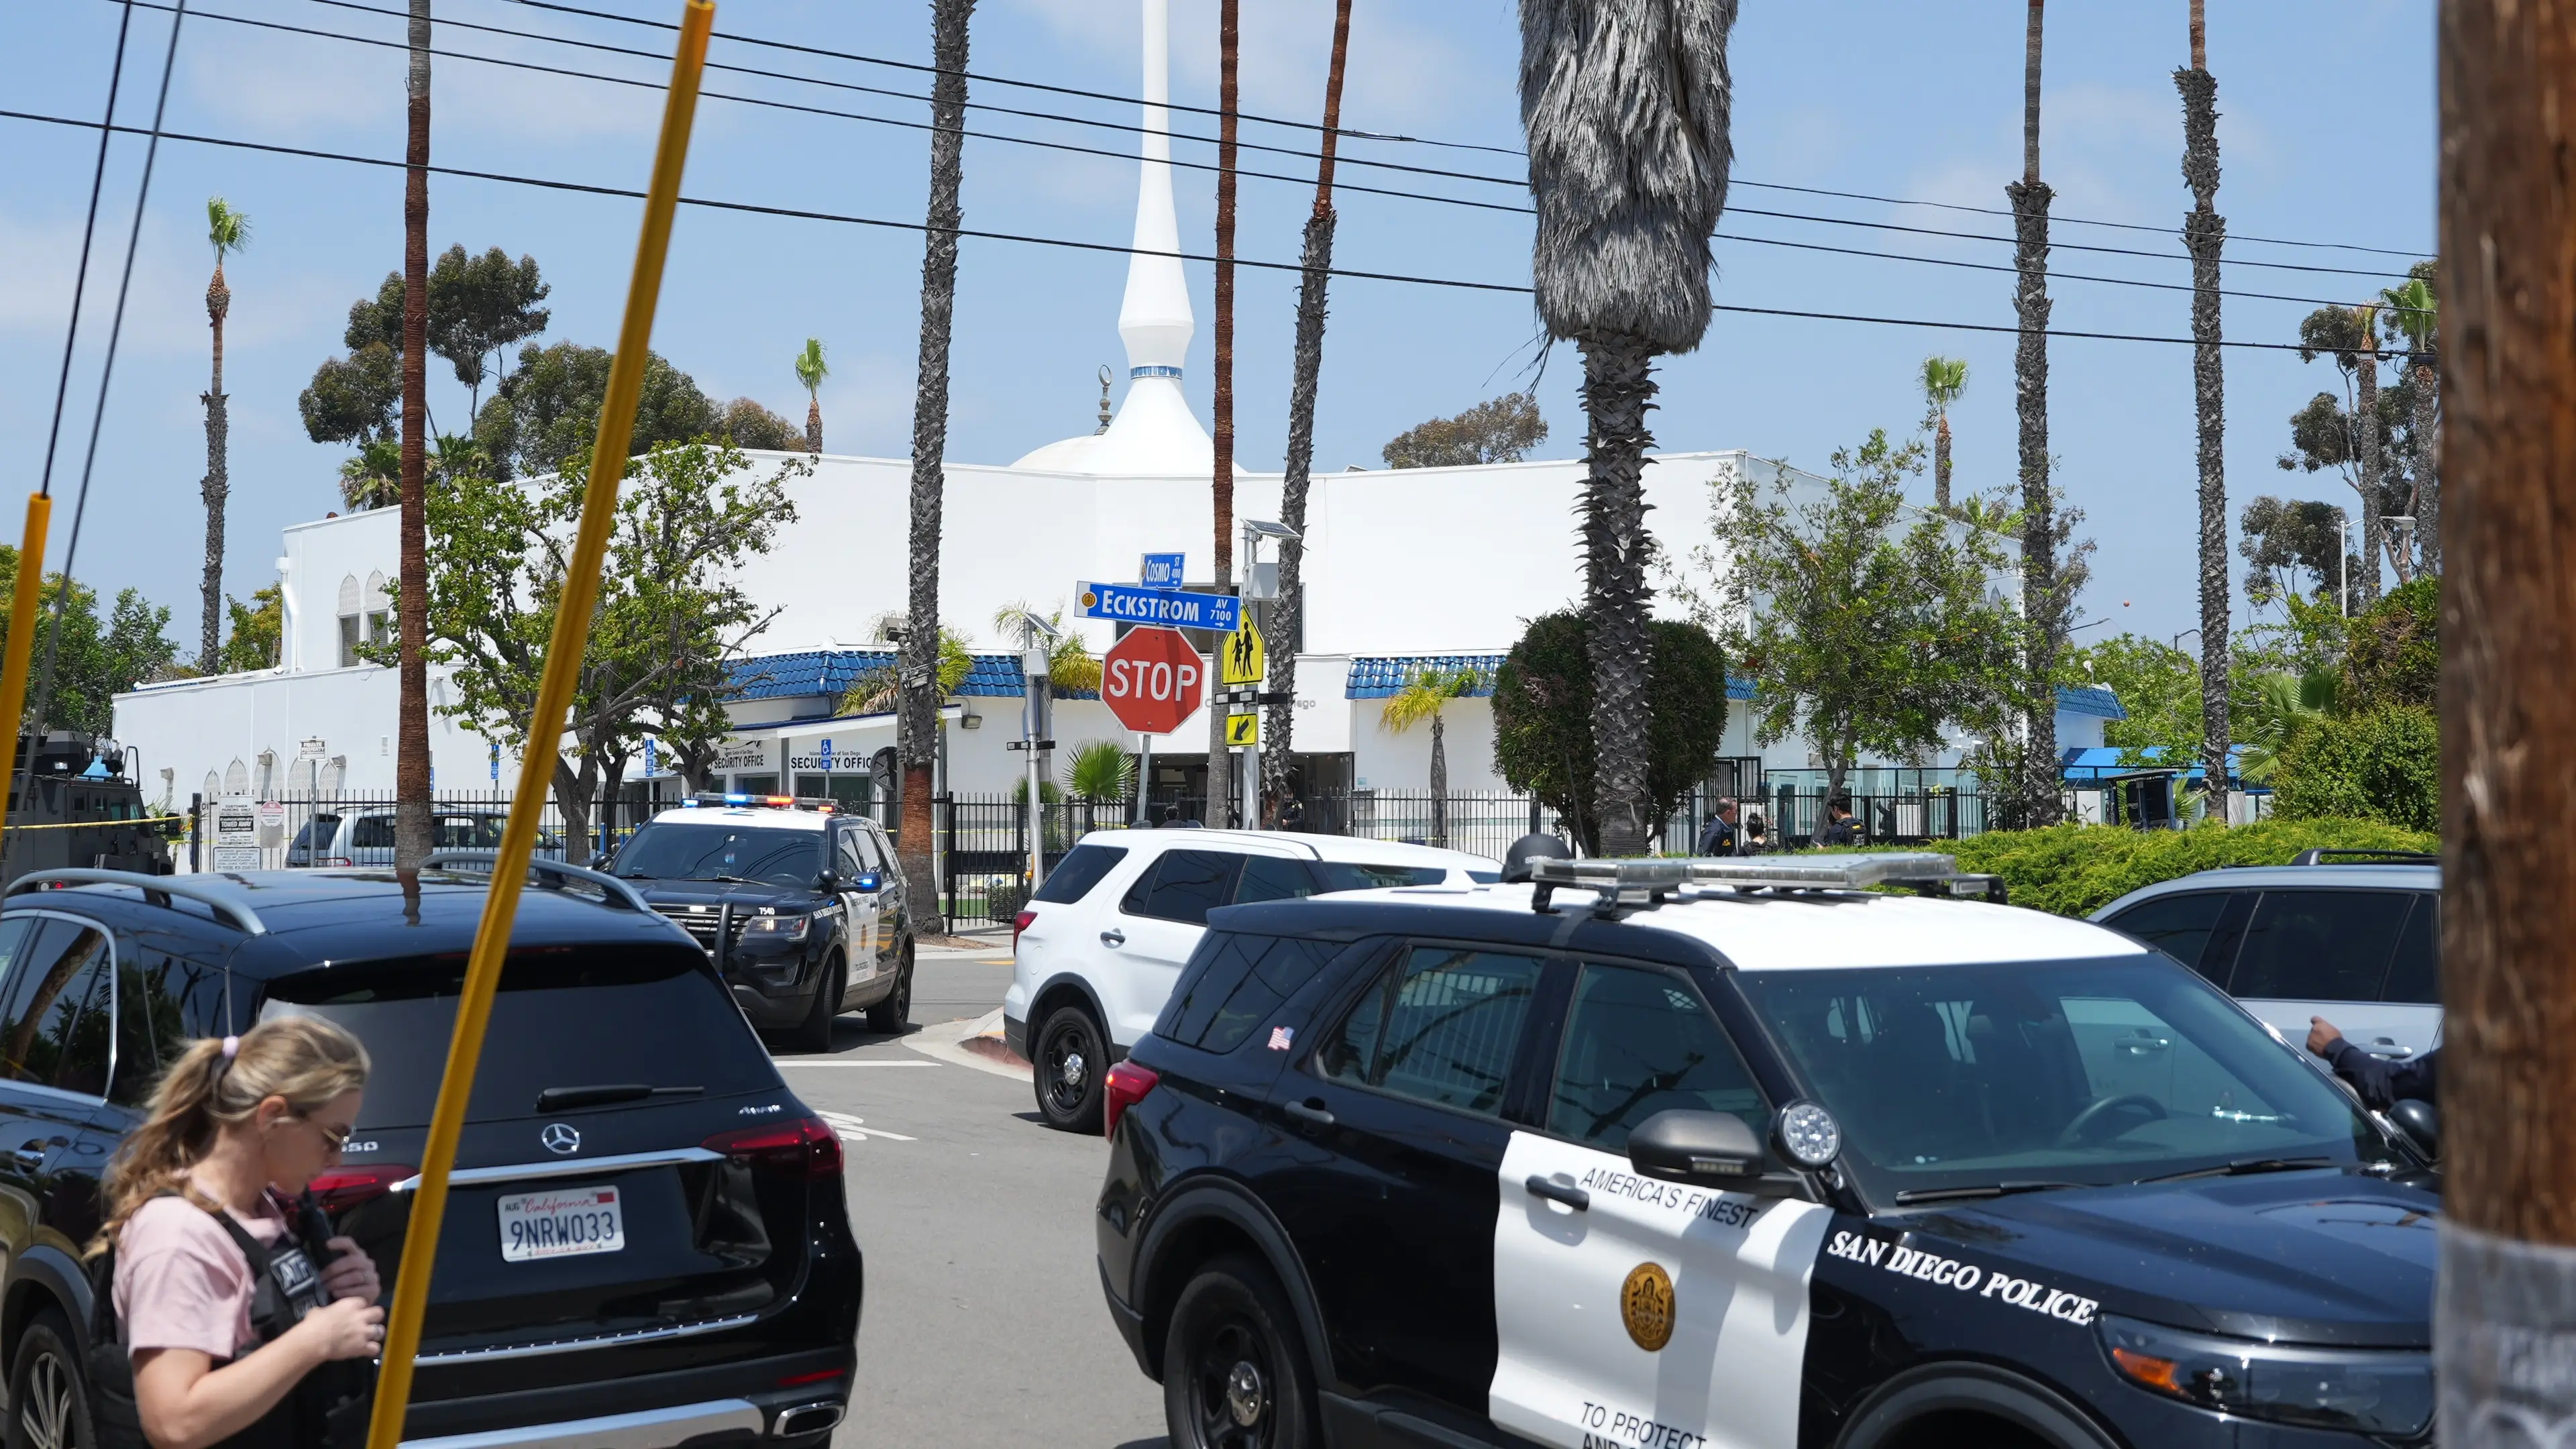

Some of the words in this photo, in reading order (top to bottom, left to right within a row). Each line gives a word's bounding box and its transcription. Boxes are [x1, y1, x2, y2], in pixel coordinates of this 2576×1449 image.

[1146, 559, 1170, 582] COSMO
[1174, 556, 1179, 567] ST
[1171, 568, 1181, 579] 4100
[1102, 590, 1199, 622] ECKSTROM
[1215, 598, 1228, 608] AV
[1210, 609, 1232, 621] 7100
[1108, 658, 1197, 702] STOP
[714, 756, 742, 769] SECURITY
[743, 755, 763, 767] OFFICE
[525, 1197, 598, 1215] California
[1580, 1167, 1682, 1209] AMERICA'S
[1683, 1193, 1758, 1228] FINEST
[510, 1212, 614, 1251] 9NRW033
[1827, 1230, 1890, 1267] SAN
[1884, 1245, 1982, 1290] DIEGO
[1980, 1273, 2099, 1326] POLICE
[1581, 1401, 1606, 1428] TO
[1611, 1411, 1707, 1449] PROTECT
